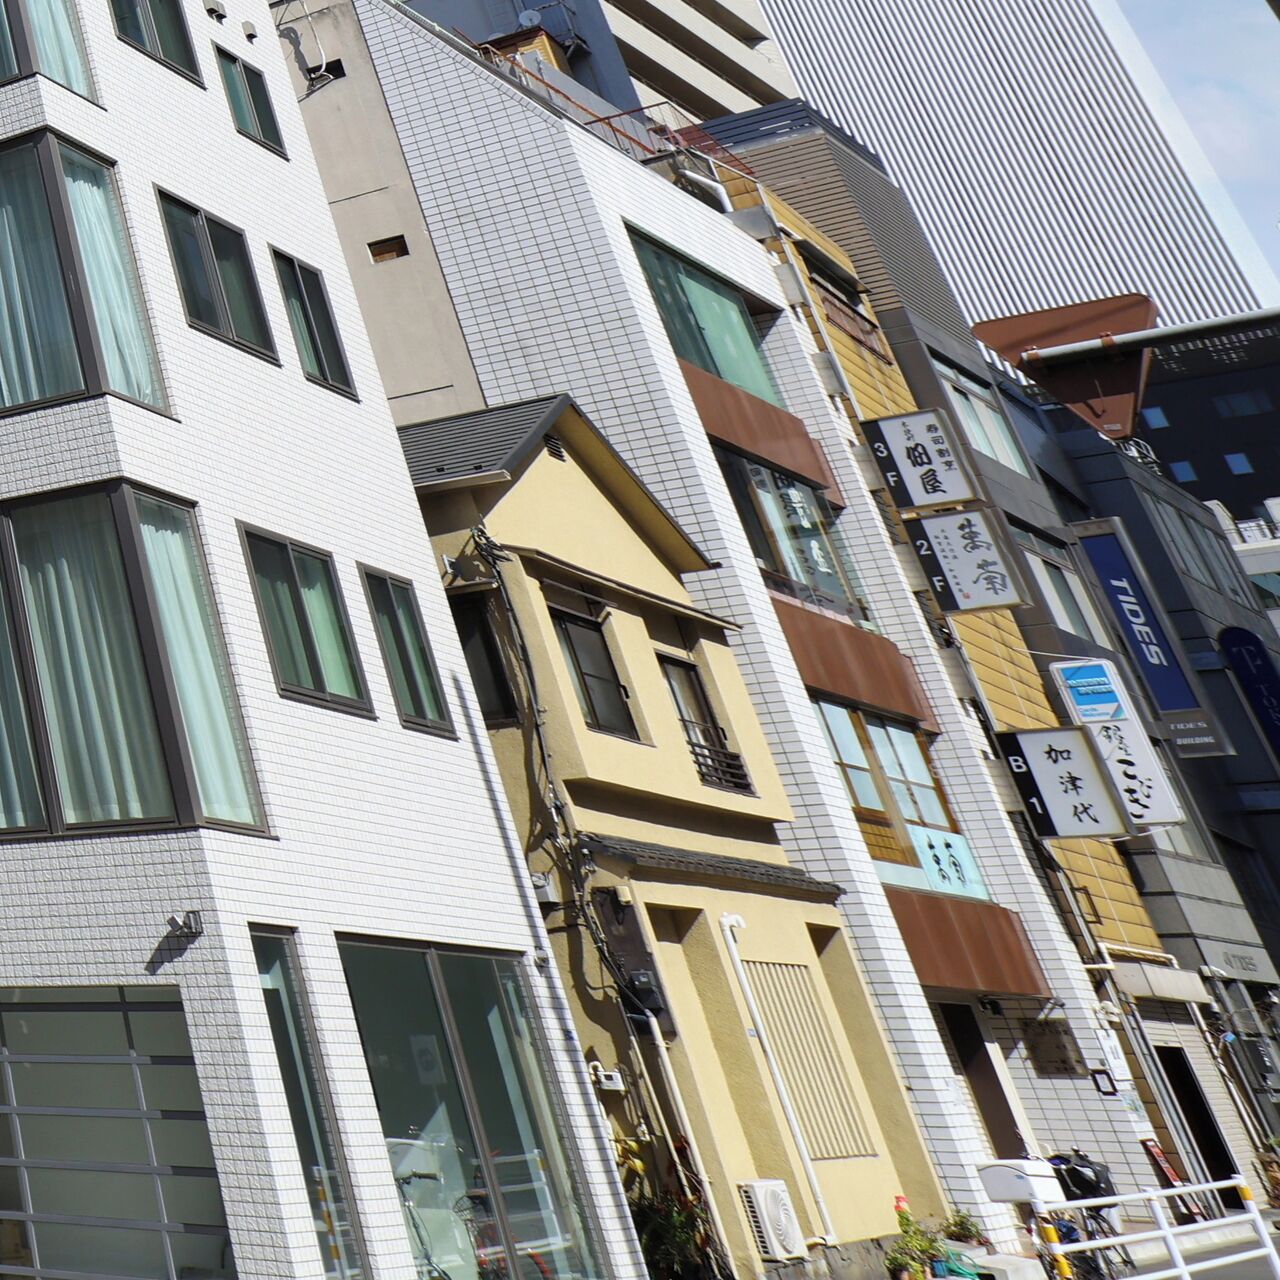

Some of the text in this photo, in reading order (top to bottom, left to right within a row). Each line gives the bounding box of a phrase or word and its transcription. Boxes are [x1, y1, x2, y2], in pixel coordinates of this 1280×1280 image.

[873, 443, 898, 487] 3F
[916, 540, 945, 592] 2F
[1109, 577, 1169, 668] TIDES
[1170, 721, 1208, 731] TIDES
[1177, 735, 1217, 745] BUILDING
[1008, 756, 1043, 815] B1
[1043, 743, 1100, 824] 加津代
